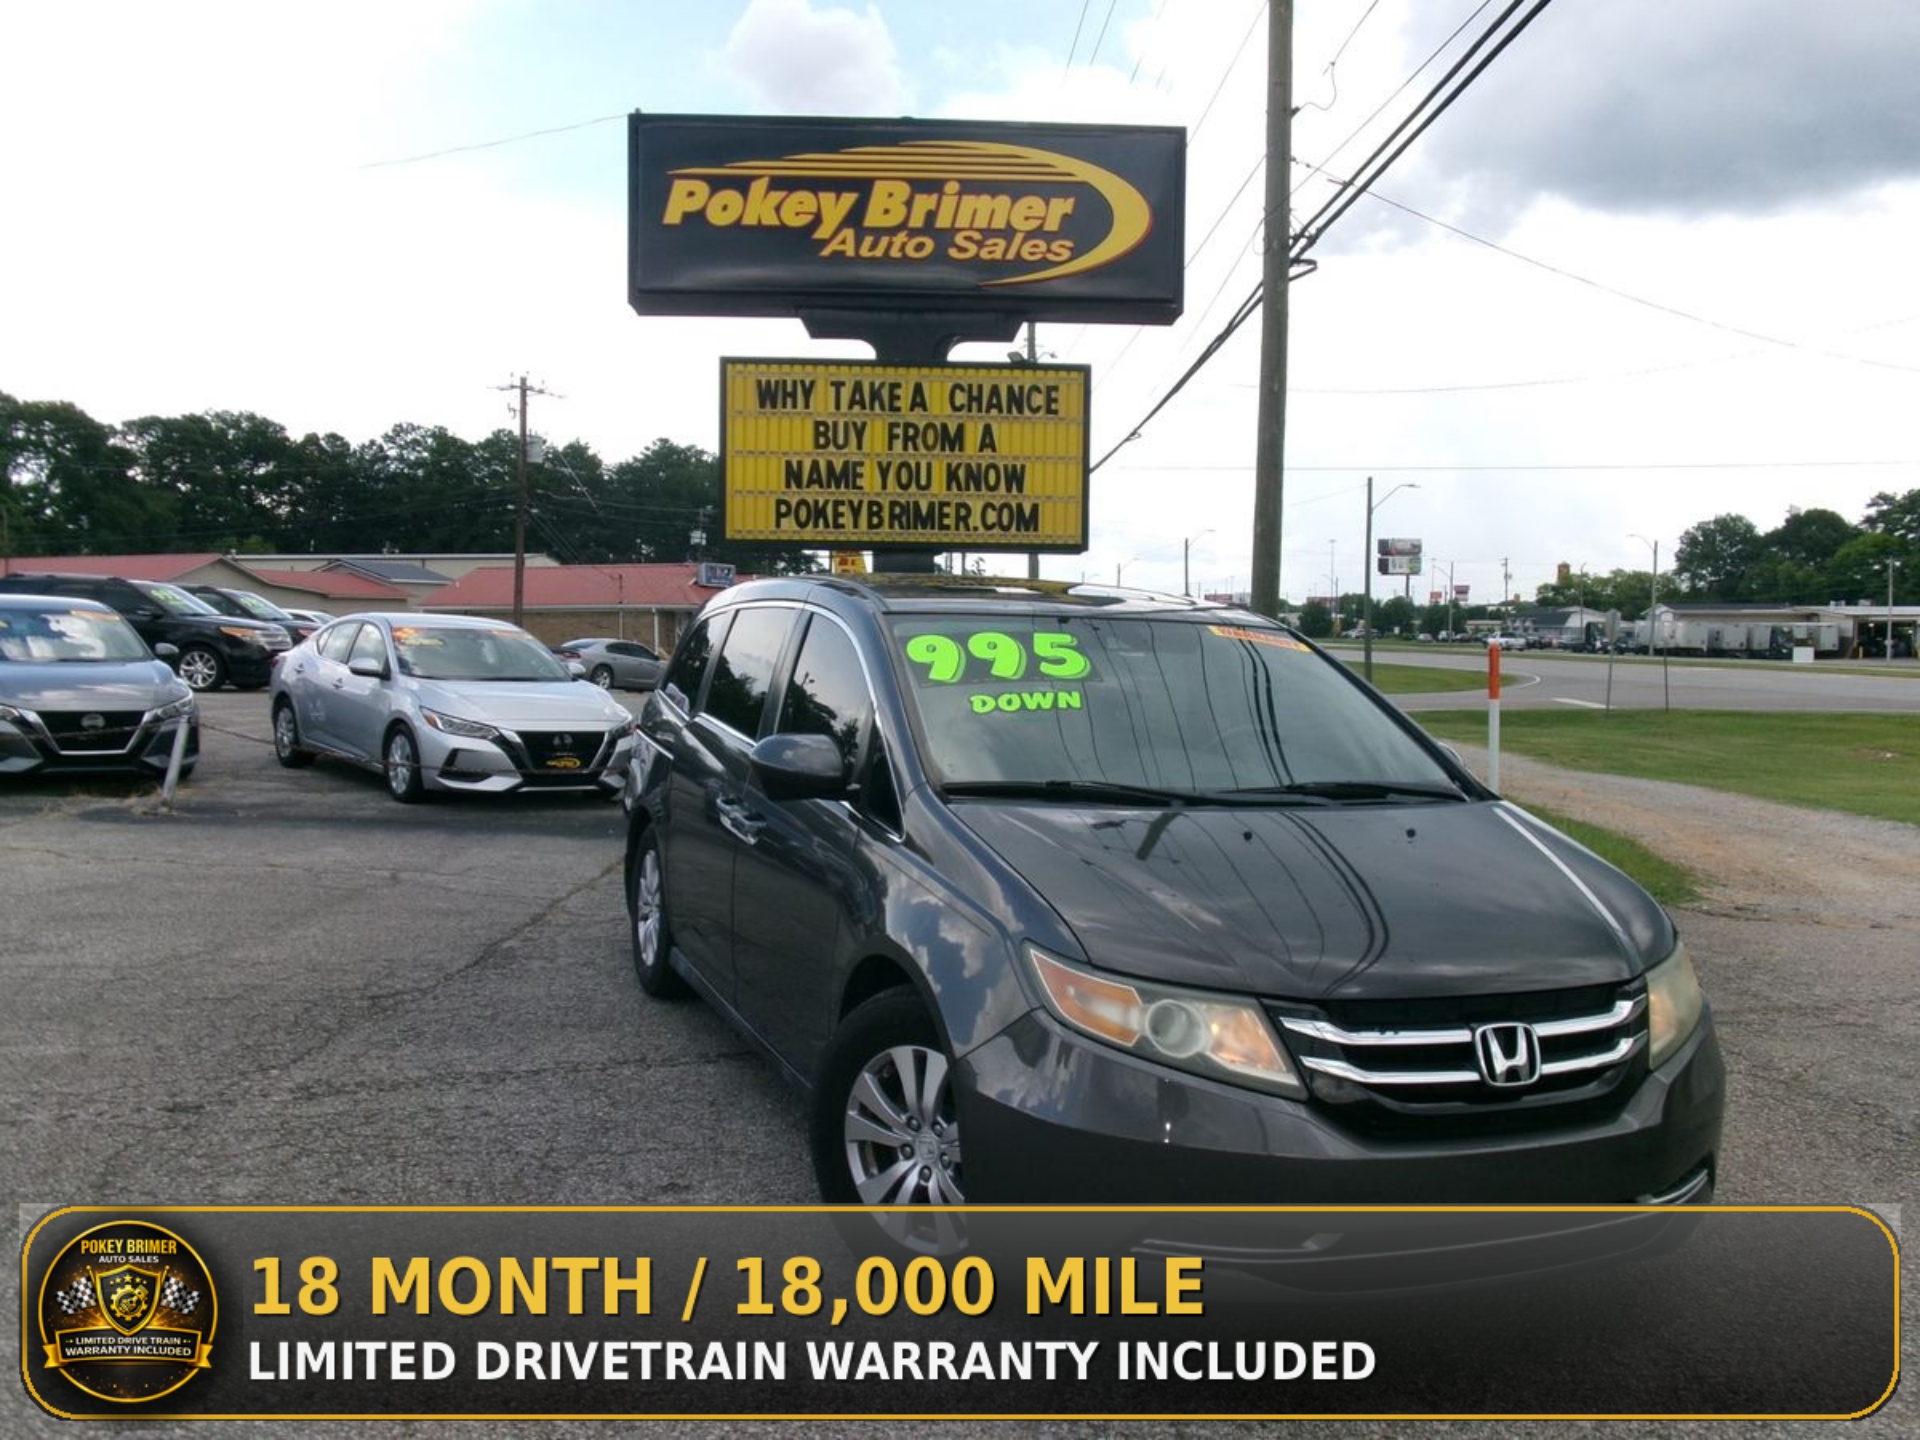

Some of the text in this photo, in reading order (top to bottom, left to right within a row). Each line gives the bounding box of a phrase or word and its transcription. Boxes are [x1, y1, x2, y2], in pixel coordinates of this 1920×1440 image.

[662, 176, 1075, 239] Pokey Brimer
[819, 228, 1074, 262] Auto Sales
[756, 379, 1059, 415] WHY TAKE A CHANCE
[814, 420, 997, 453] BUY FROM A
[785, 459, 1026, 494] NAME YOU KNOW
[775, 499, 1039, 532] POKEYBRIMER.COM
[906, 631, 1091, 683] 995
[969, 690, 1083, 714] DOWN
